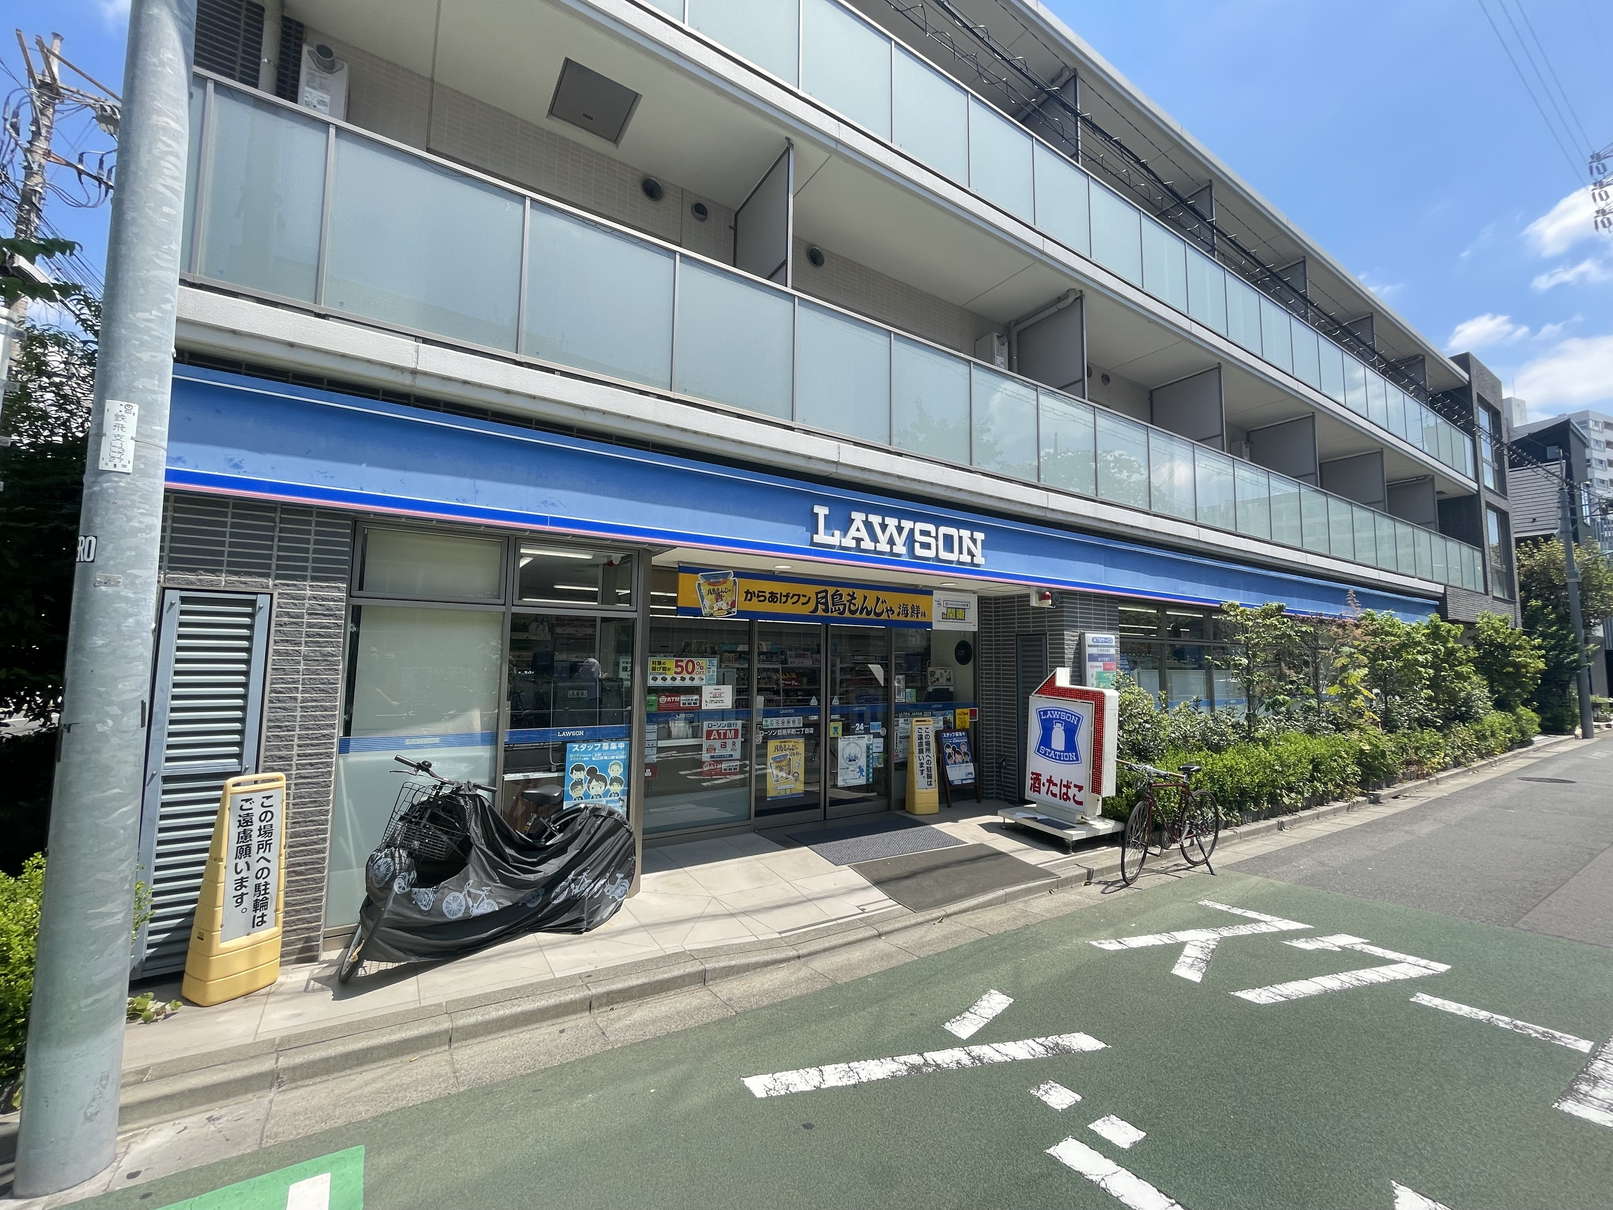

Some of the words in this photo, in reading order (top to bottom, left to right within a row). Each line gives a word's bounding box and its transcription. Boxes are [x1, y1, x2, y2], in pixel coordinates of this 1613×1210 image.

[813, 504, 985, 565] LAWSON
[743, 588, 812, 606] からあげクン
[809, 587, 894, 619] 月島もんじゃ
[673, 658, 704, 675] 50%
[1040, 710, 1080, 726] LAWSON
[557, 730, 585, 738] LAWSON
[710, 730, 735, 740] ATM
[572, 742, 625, 752] スタッフ募集中
[1039, 746, 1078, 762] STATION
[1029, 771, 1084, 807] 酒・たばこ
[233, 797, 254, 914] ご遠慮願います。
[251, 794, 274, 929] この場所への駐輪は
